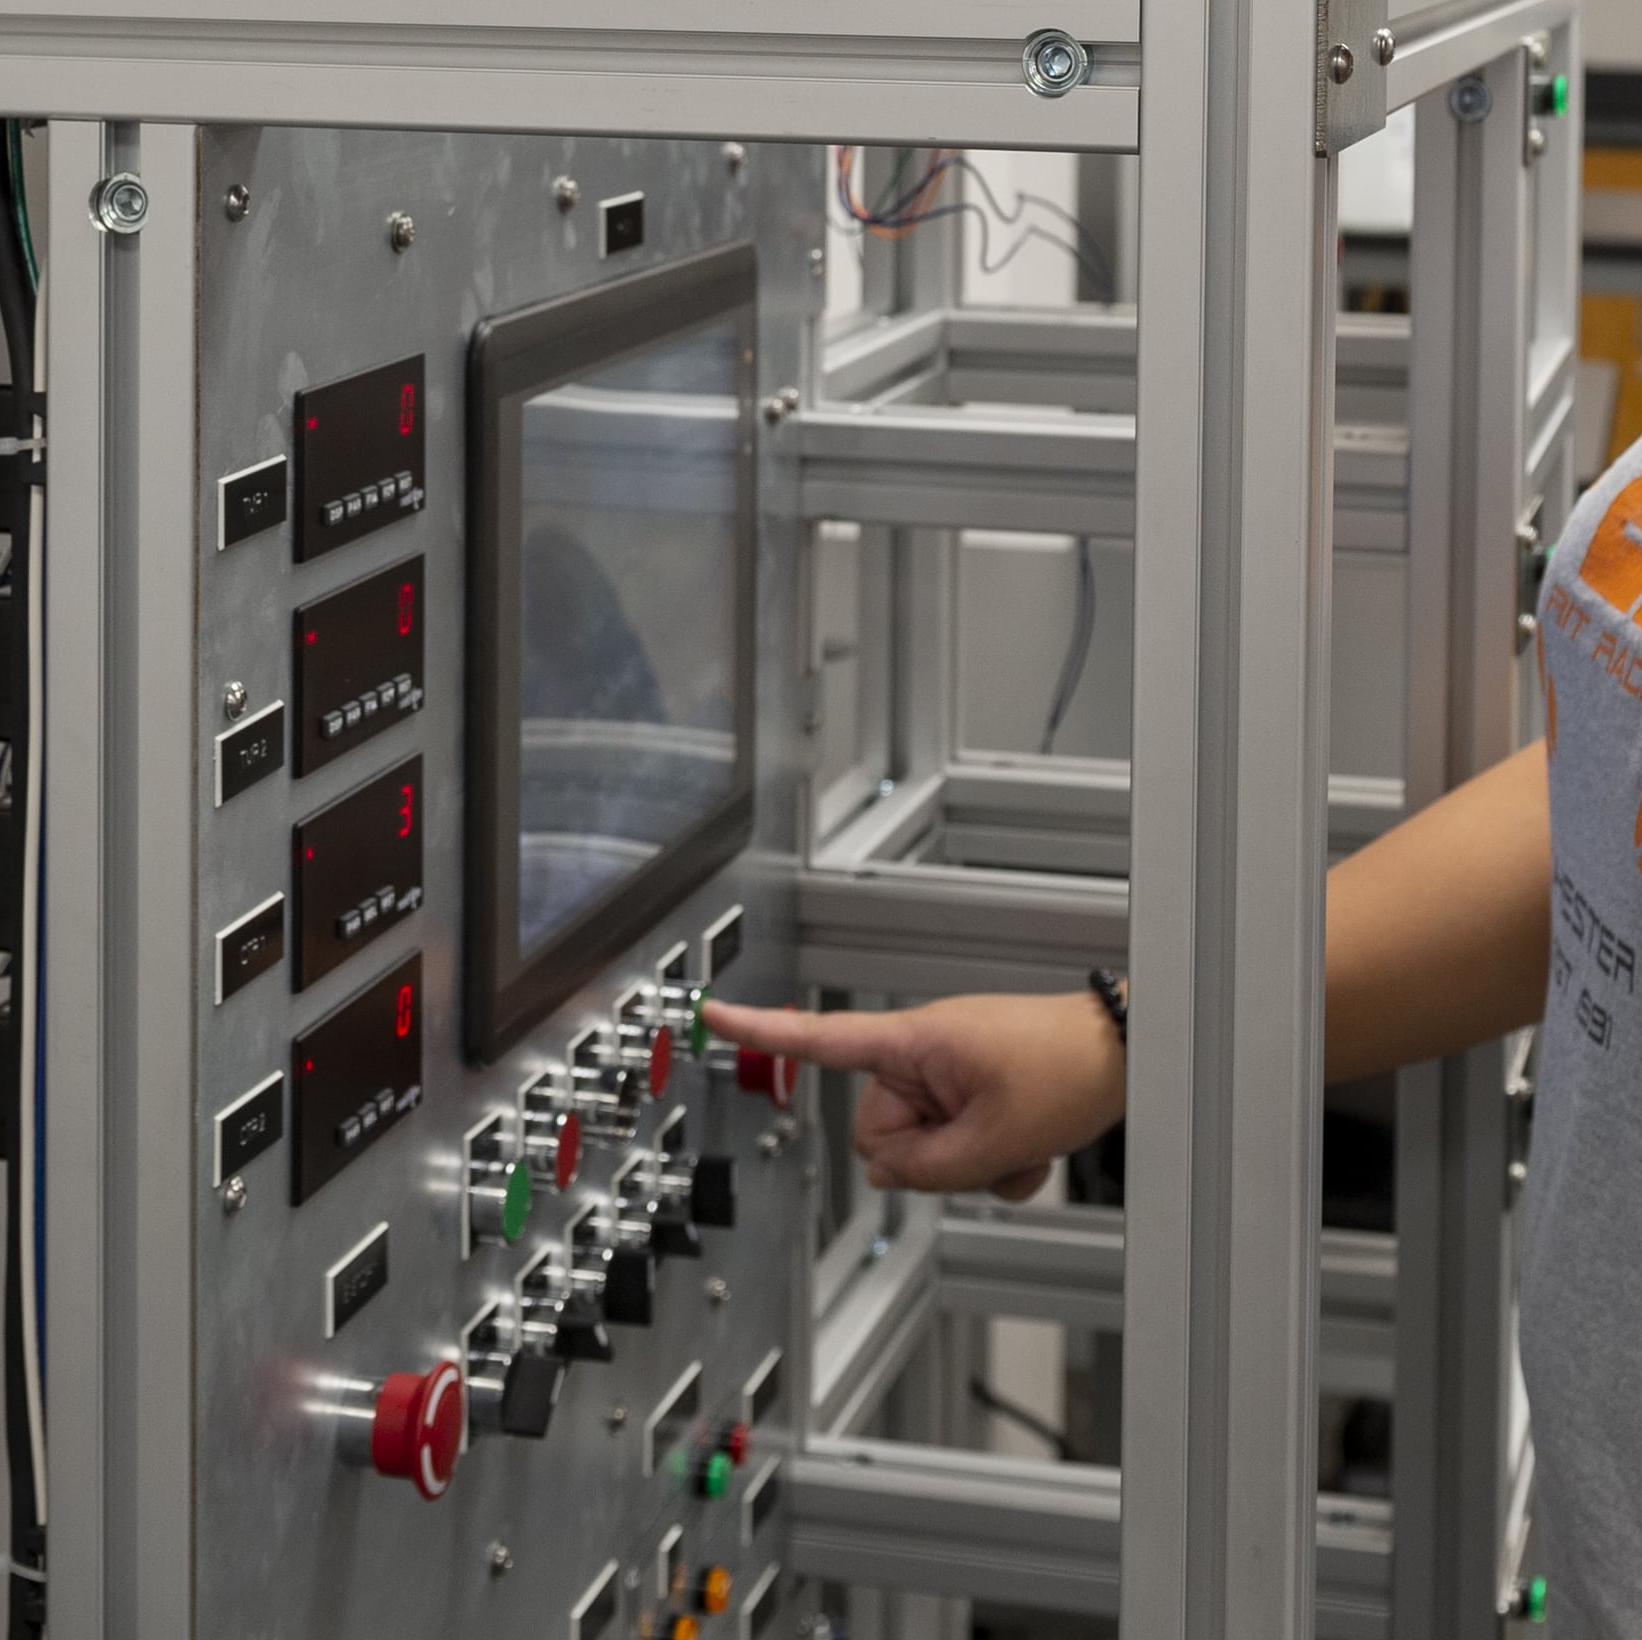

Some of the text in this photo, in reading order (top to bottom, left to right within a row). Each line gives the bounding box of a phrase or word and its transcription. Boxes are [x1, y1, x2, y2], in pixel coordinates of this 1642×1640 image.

[399, 384, 414, 435] 0
[398, 583, 413, 636] 0
[1545, 584, 1591, 643] RIT
[398, 784, 413, 837] 3
[1556, 872, 1636, 994] ESTER
[395, 983, 413, 1038] 0
